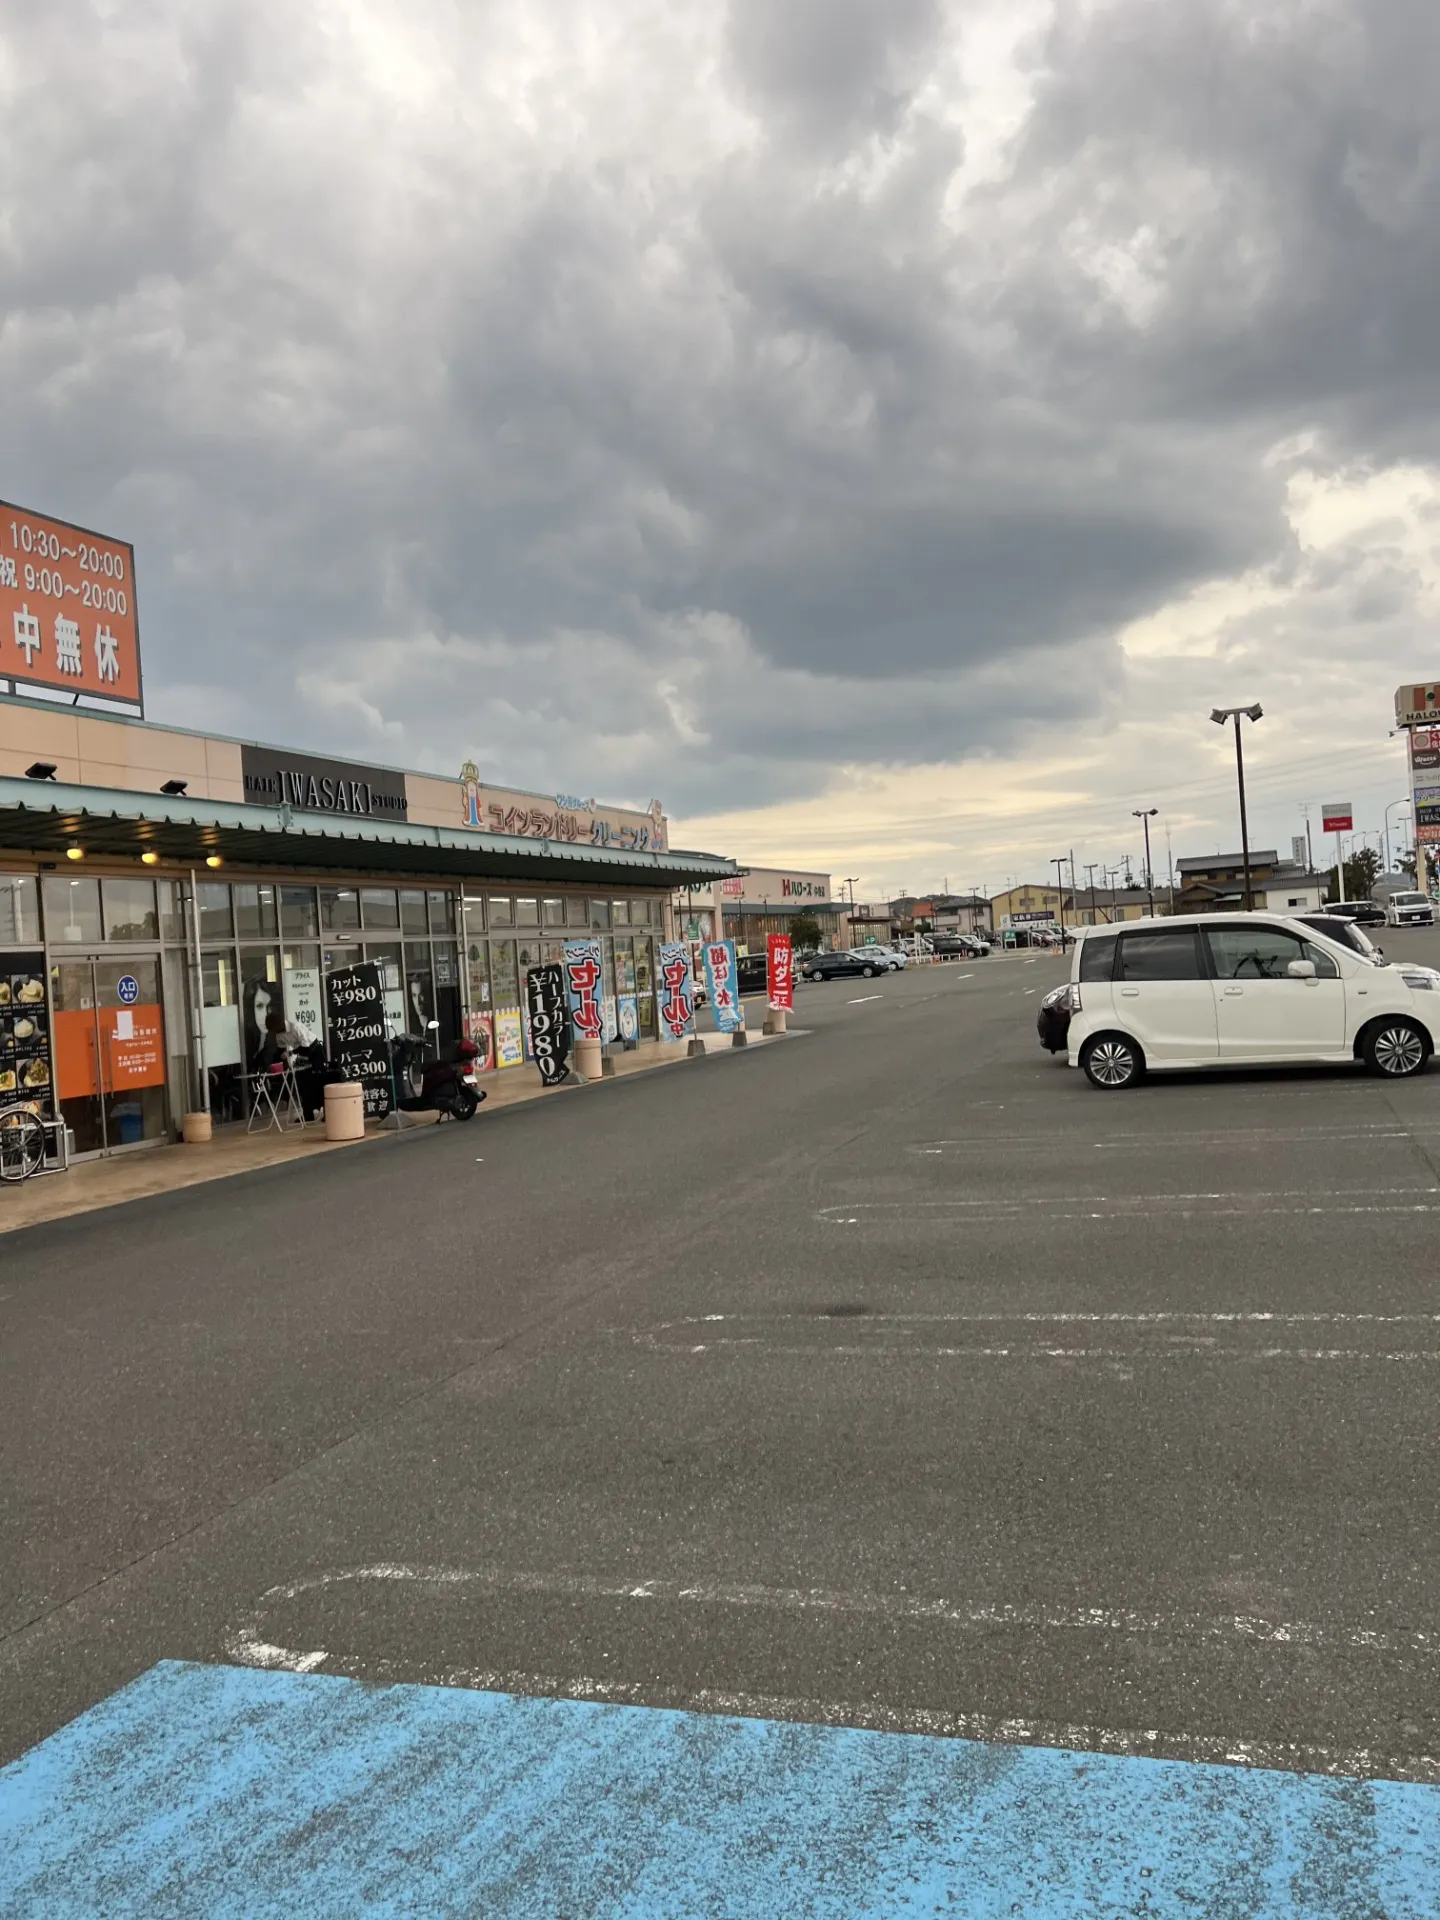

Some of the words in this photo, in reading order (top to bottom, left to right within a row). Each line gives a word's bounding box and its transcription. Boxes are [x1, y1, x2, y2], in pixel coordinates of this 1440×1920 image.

[13, 603, 120, 683] 中無休
[1406, 710, 1440, 721] HALO
[245, 775, 277, 793] HAIR
[277, 770, 373, 814] IWASAKI
[373, 793, 408, 810] STUDIO
[489, 802, 590, 843] コインランドリー
[590, 820, 649, 850] クリーニング
[791, 880, 812, 897] ハローズ
[773, 947, 790, 995] 防ダニ
[120, 981, 136, 993] 入口
[331, 974, 361, 991] カット
[333, 986, 376, 1006] ¥980
[295, 1009, 316, 1024] ¥690
[336, 1015, 369, 1028] カラー
[530, 972, 556, 1077] ¥1980
[337, 1023, 382, 1041] ¥2600
[341, 1049, 373, 1064] パーマ
[341, 1060, 387, 1078] ¥3300
